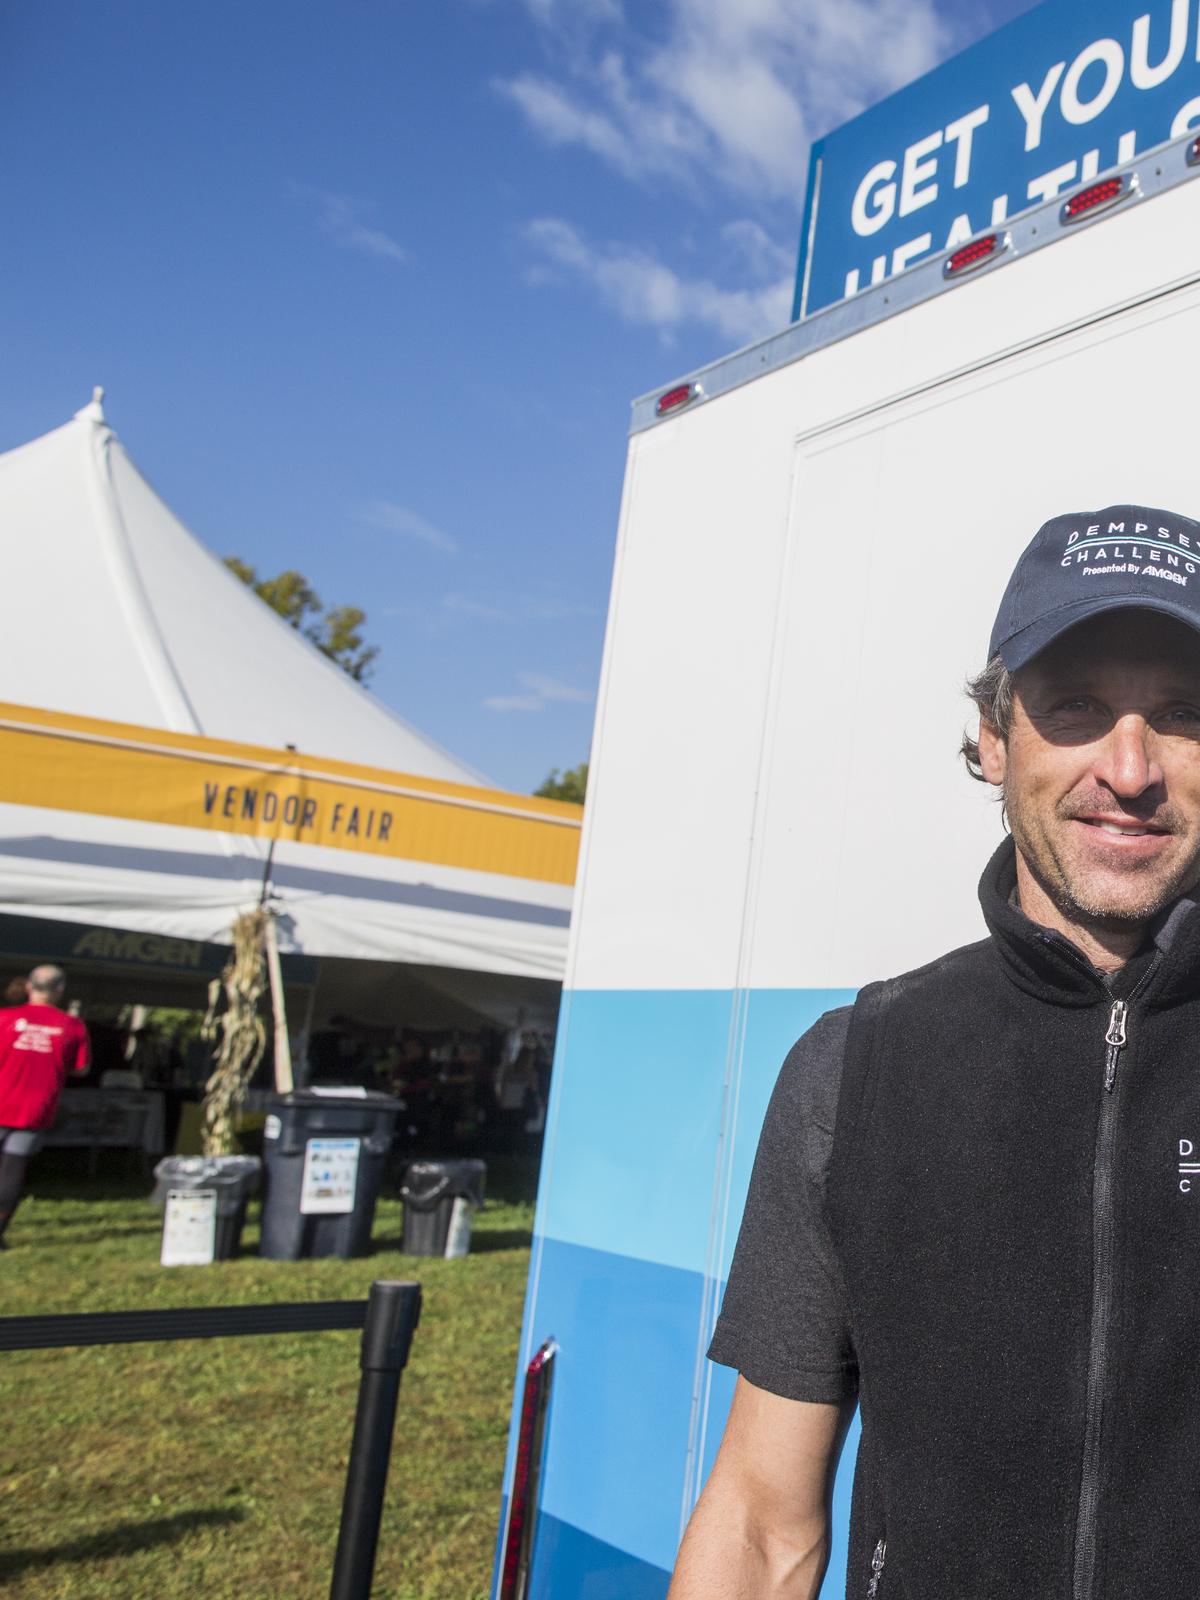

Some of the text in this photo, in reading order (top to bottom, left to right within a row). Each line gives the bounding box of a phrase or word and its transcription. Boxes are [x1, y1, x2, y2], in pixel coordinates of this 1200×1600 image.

[851, 104, 990, 237] GET
[1083, 563, 1188, 586] Presented By AMGEN
[204, 781, 393, 841] VENDOR FAIR
